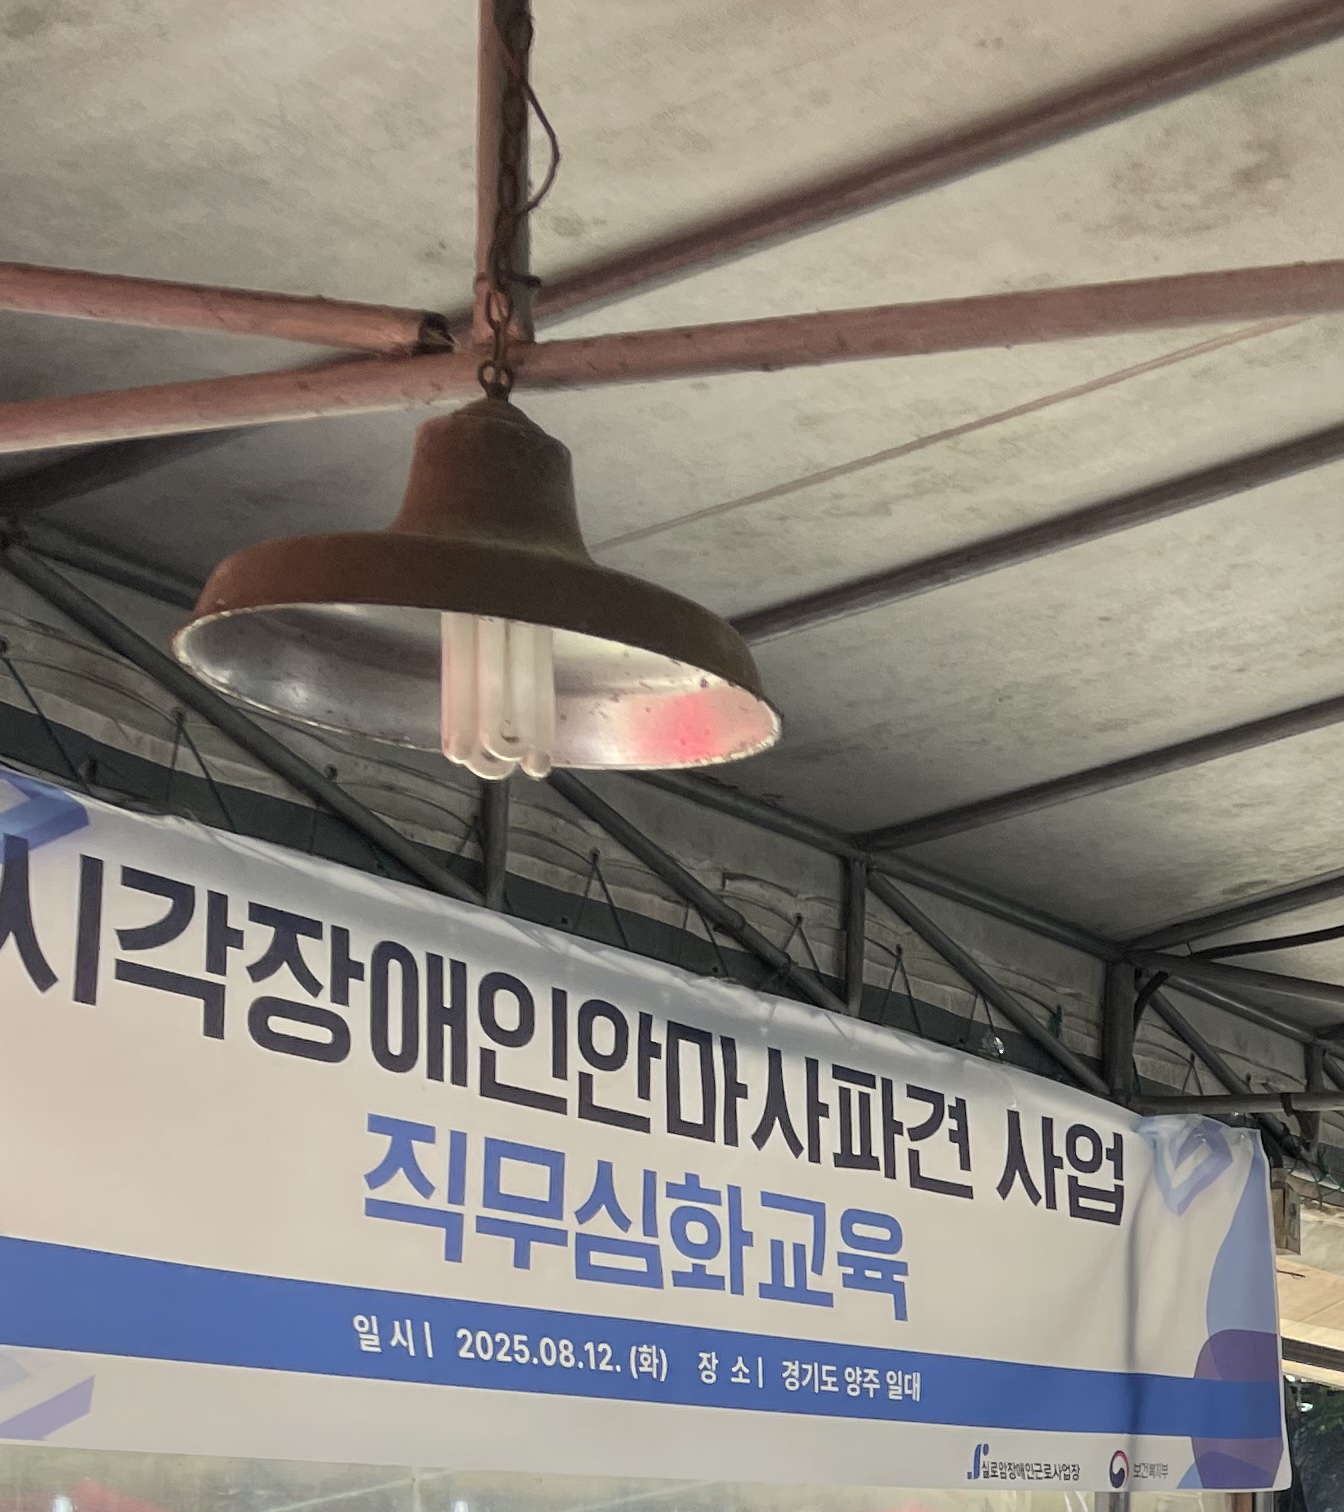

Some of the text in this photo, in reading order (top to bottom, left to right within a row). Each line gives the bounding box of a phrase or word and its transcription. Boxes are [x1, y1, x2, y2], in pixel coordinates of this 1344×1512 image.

[0, 834, 1125, 1226] 시각장애인안마사파견 사업
[364, 1113, 909, 1322] 직무심화교육
[457, 1328, 621, 1372] 2025.08.12.
[629, 1344, 668, 1382] (화)
[782, 1360, 839, 1393] 경기도
[844, 1366, 881, 1398] 양주
[886, 1370, 922, 1402] 일대
[1133, 1463, 1168, 1480] 보건복지부
